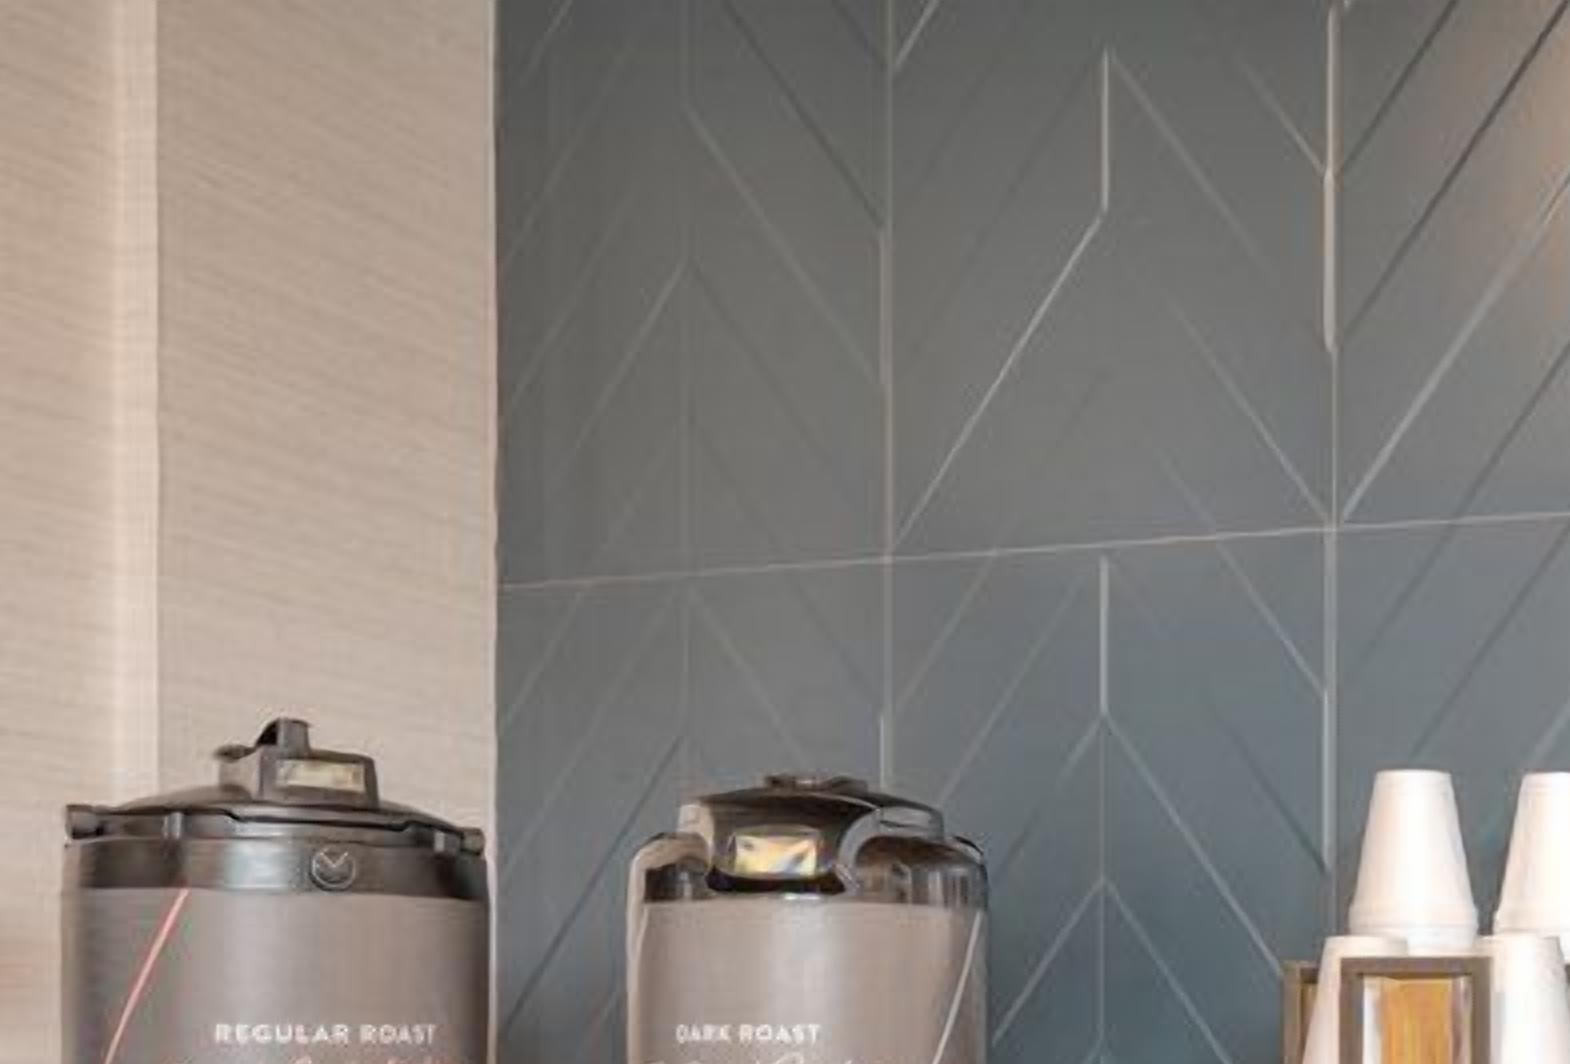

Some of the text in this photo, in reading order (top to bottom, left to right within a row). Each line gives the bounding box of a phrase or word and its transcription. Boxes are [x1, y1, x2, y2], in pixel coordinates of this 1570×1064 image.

[214, 1022, 437, 1045] REGULAR ROAST
[675, 1023, 821, 1046] DARK ROAST
